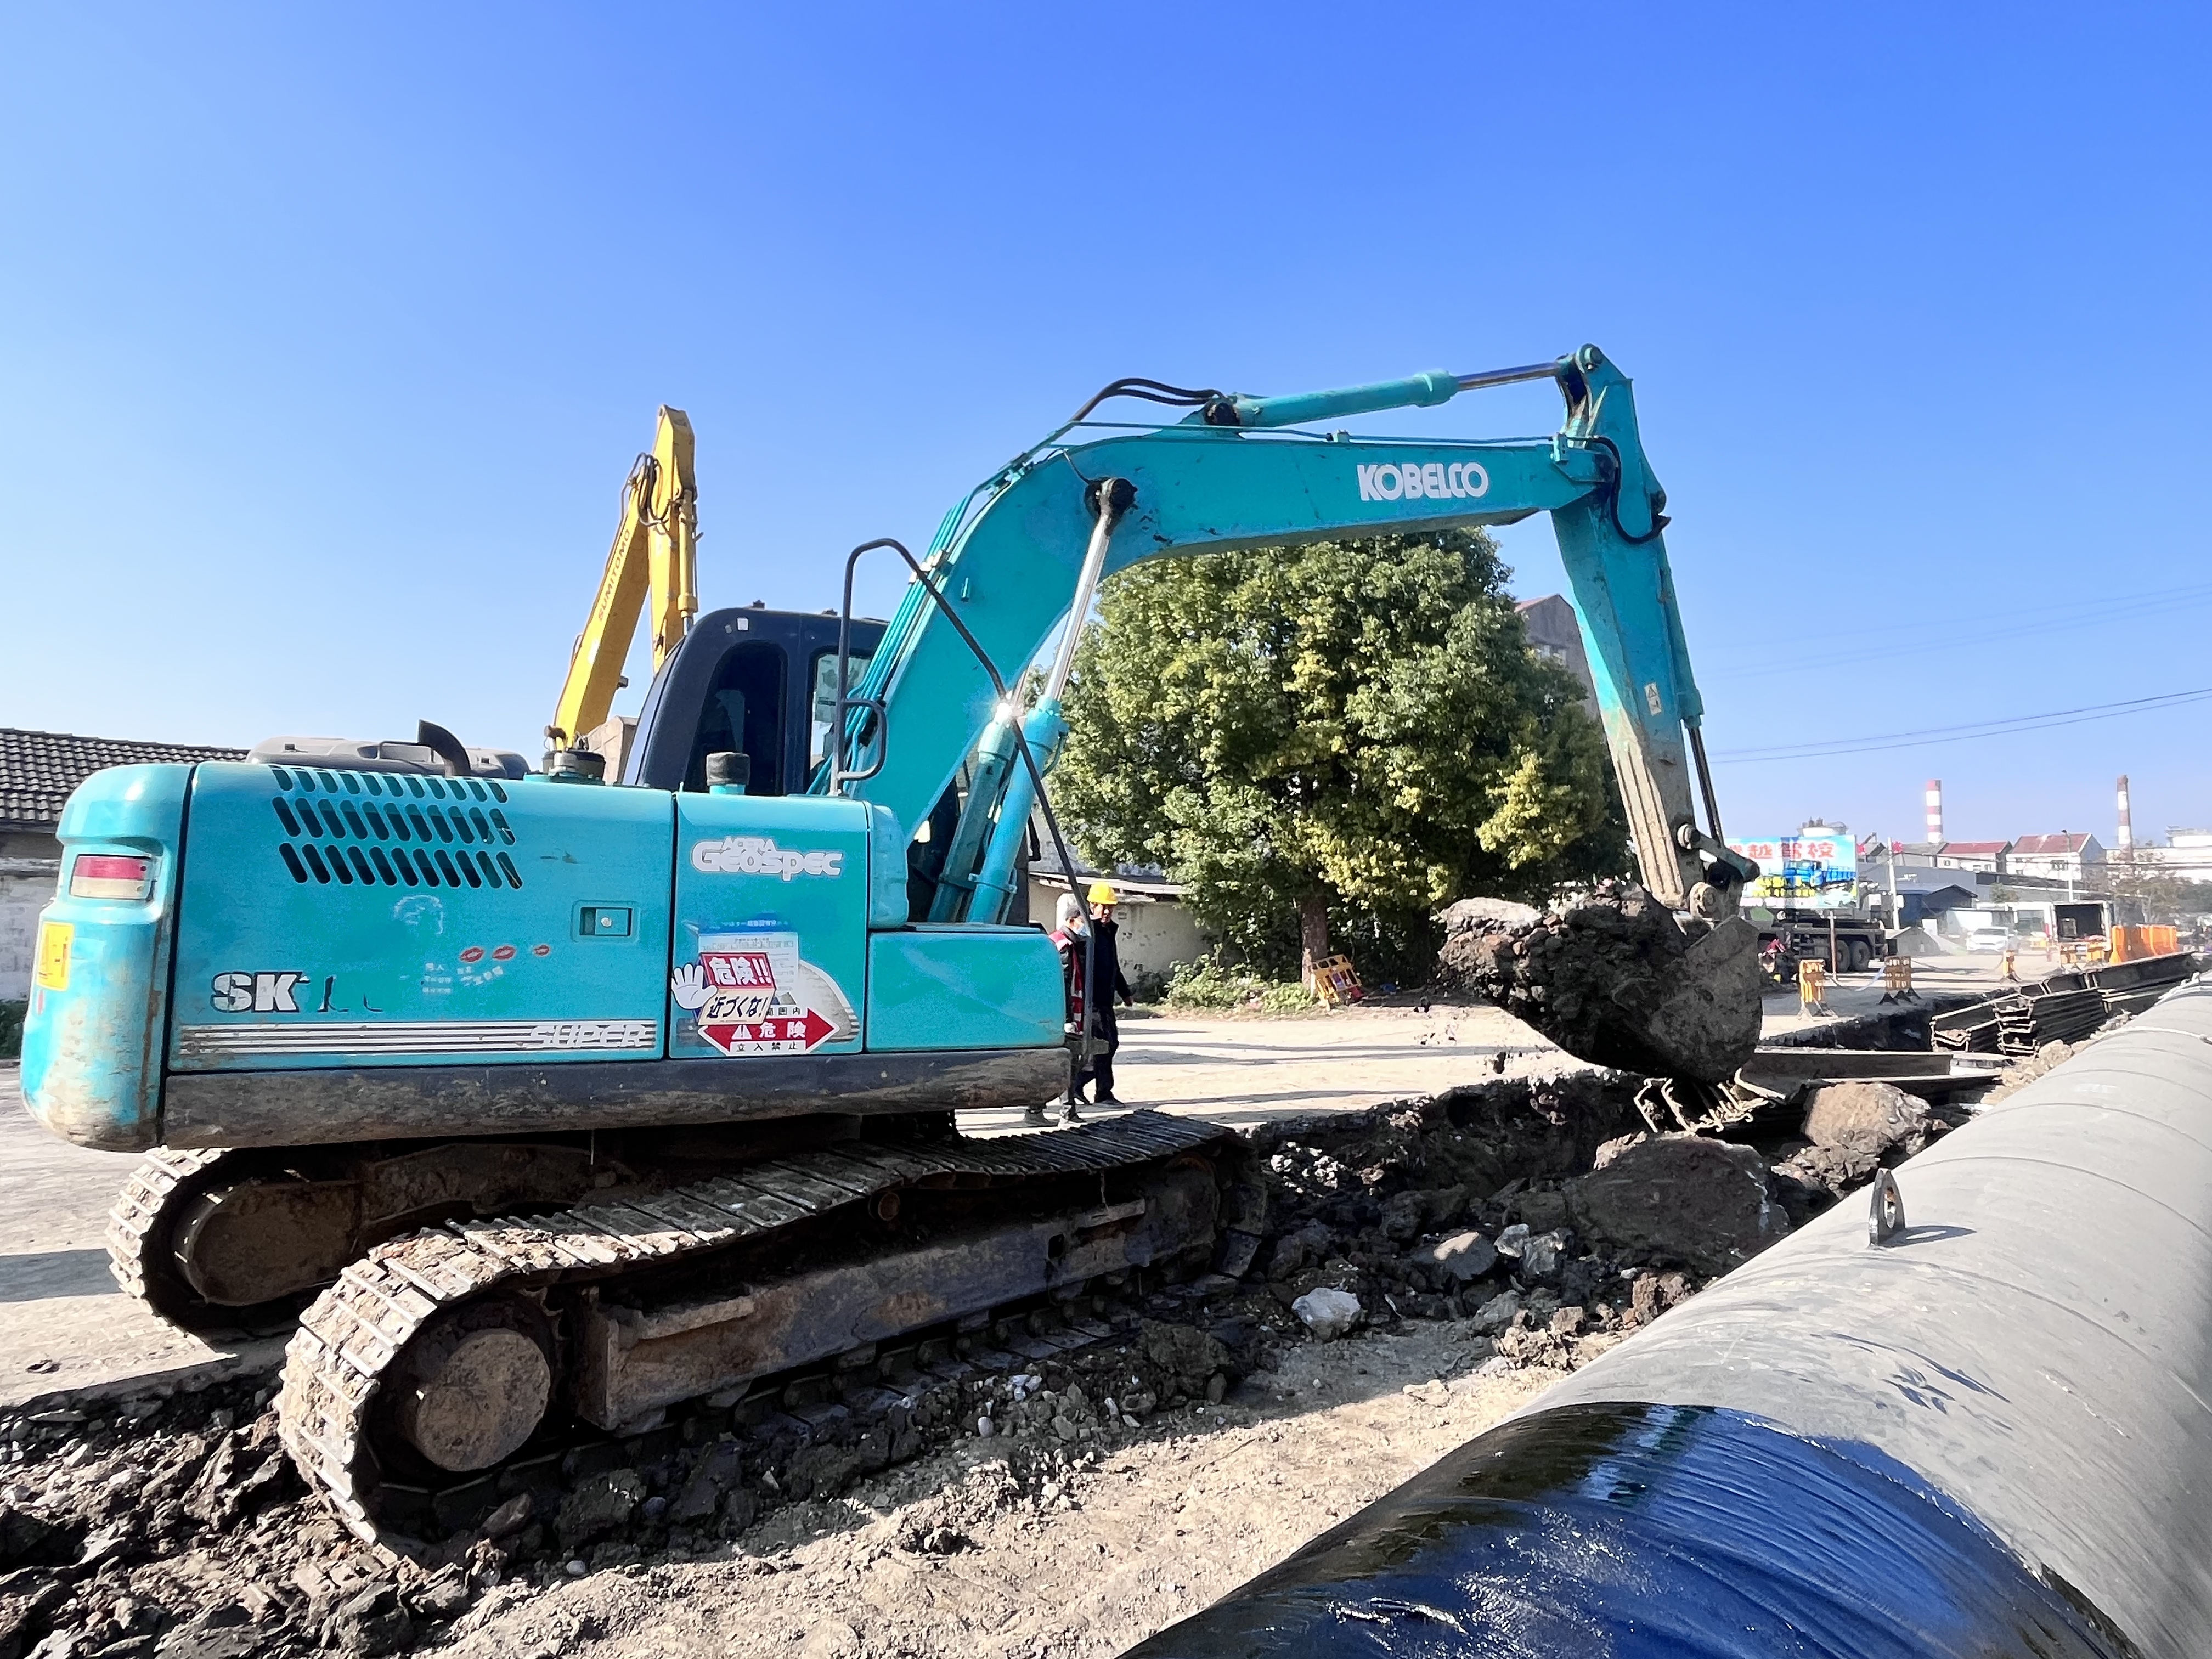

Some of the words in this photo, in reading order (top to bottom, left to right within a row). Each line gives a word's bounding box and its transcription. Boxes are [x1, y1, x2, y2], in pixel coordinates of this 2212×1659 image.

[1357, 462, 1489, 501] KOBELCO
[599, 529, 630, 622] SUMITOMO
[526, 1024, 647, 1049] SUPER
[759, 1021, 807, 1039] 危険
